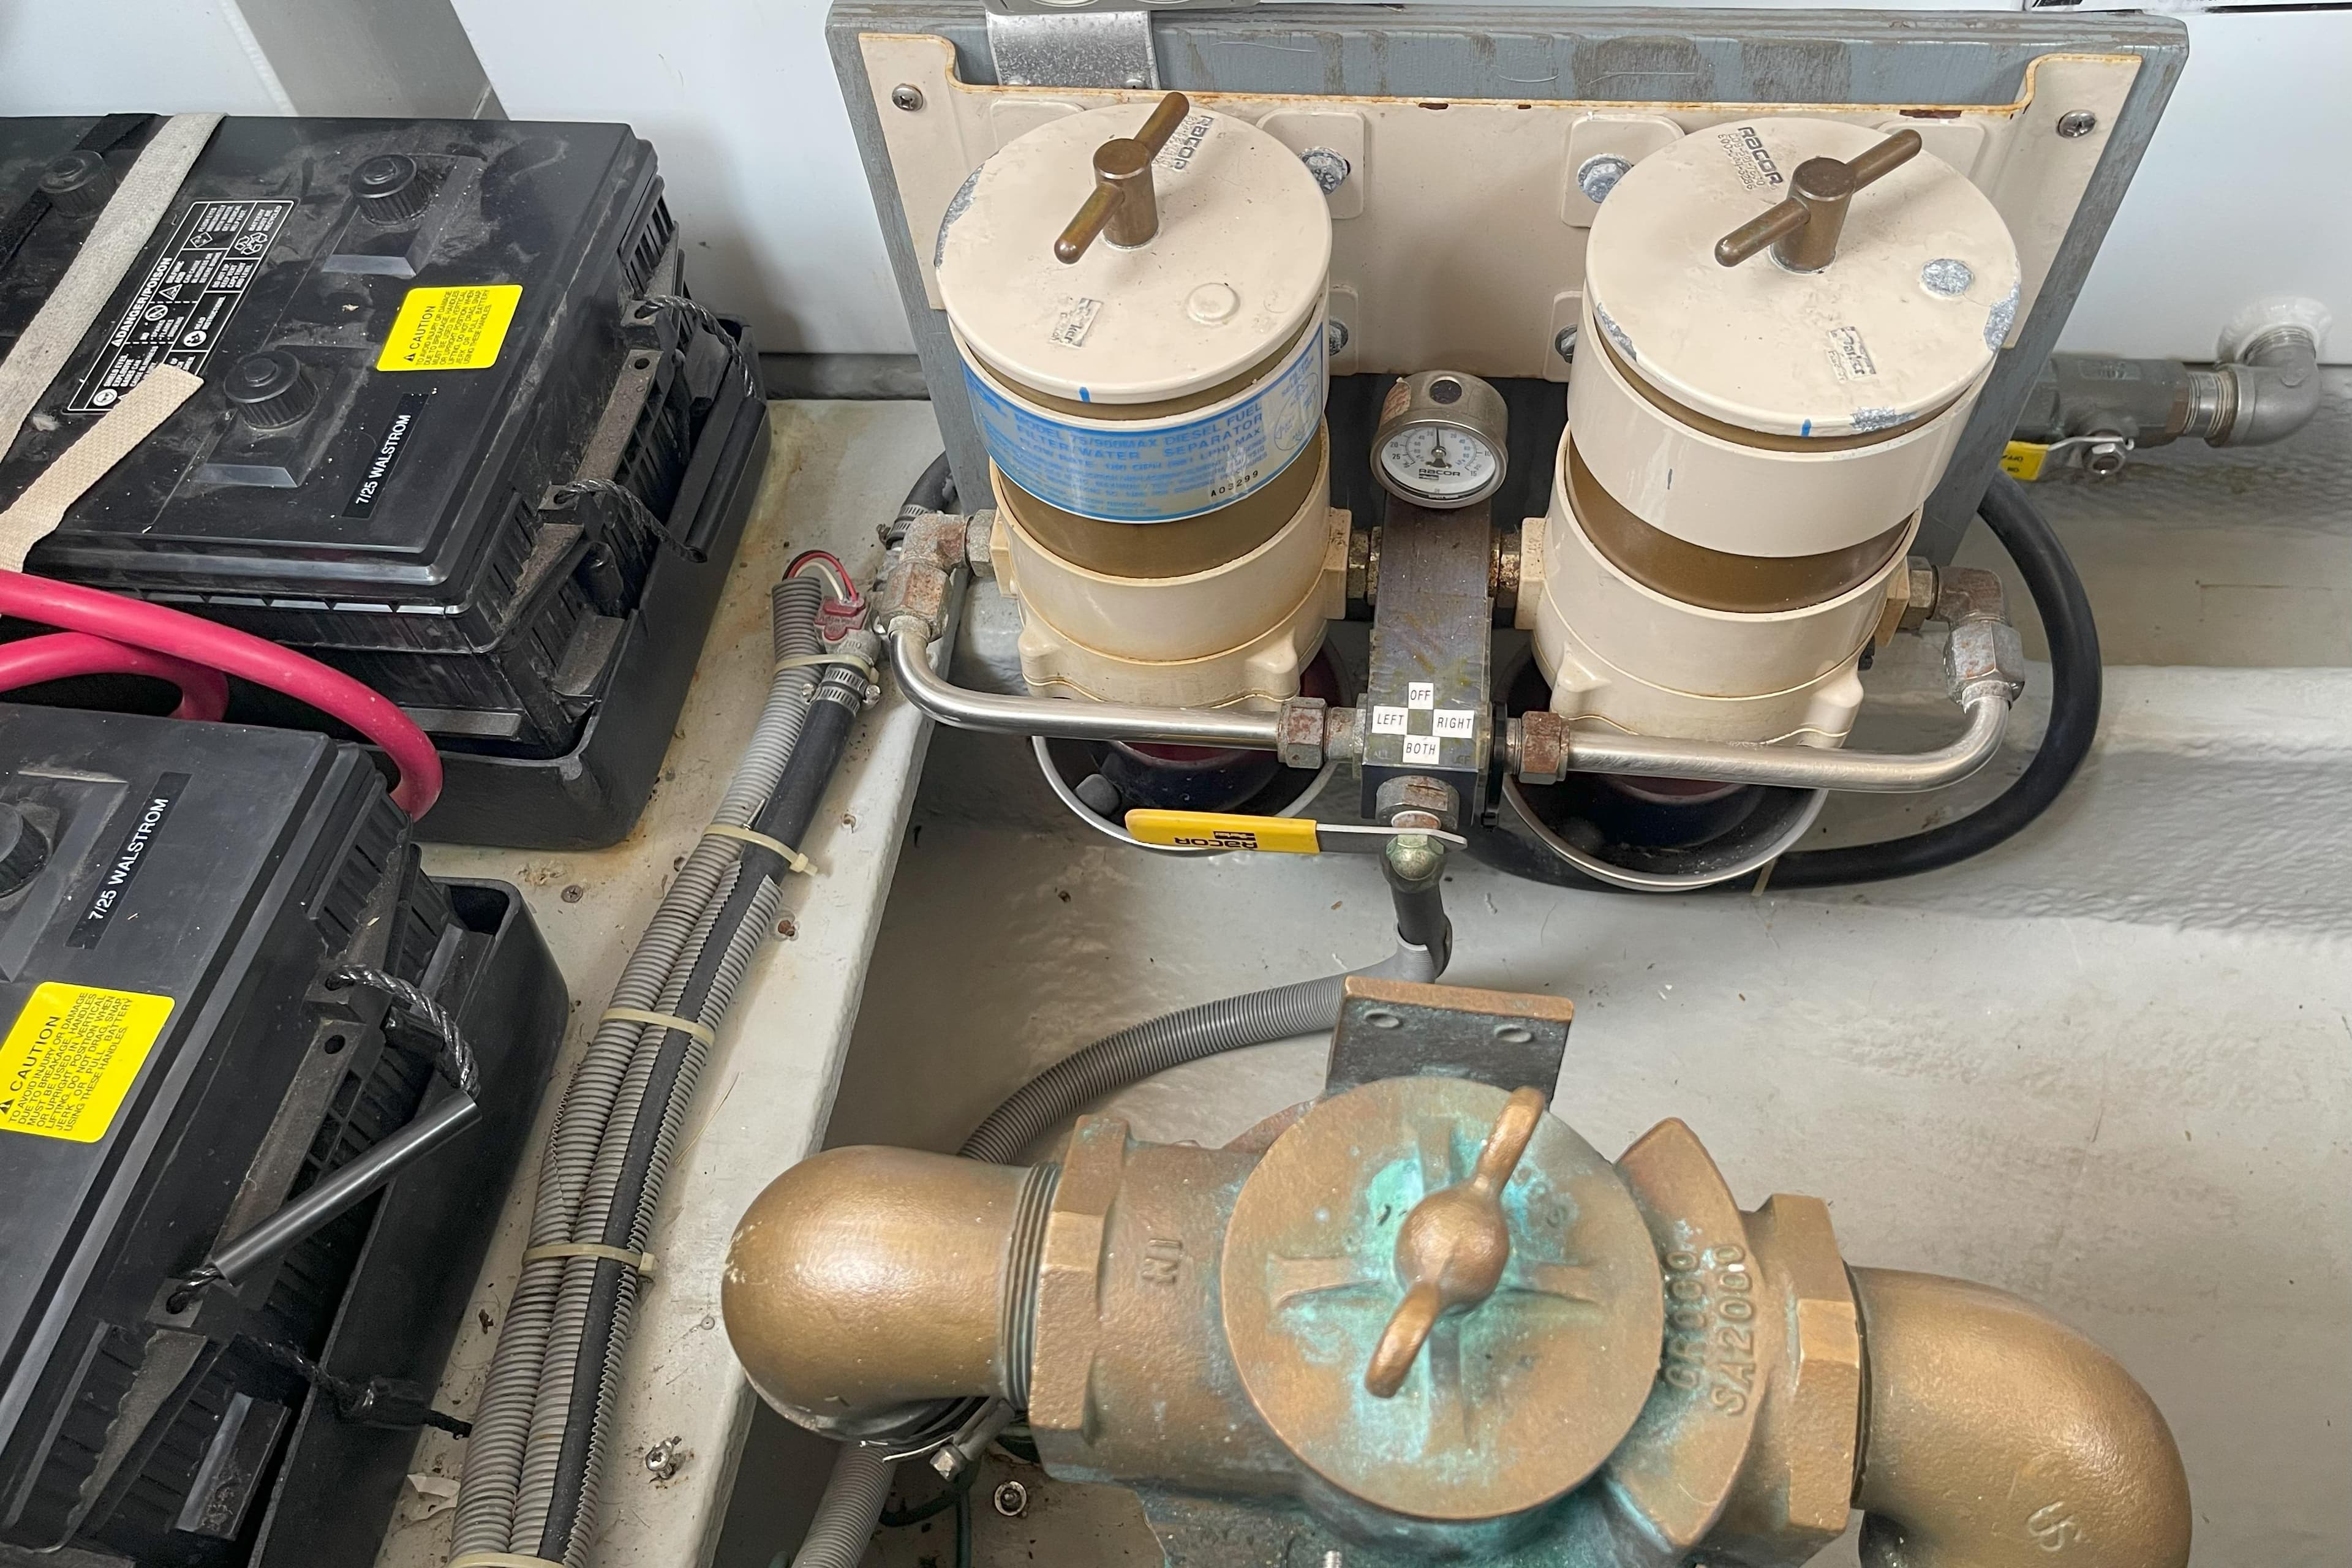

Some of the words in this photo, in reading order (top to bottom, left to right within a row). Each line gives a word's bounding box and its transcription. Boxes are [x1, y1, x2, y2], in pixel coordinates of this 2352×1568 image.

[248, 209, 266, 231] BATTERY
[263, 205, 282, 231] RECYCLED
[115, 258, 172, 338] DANGER/POISON
[174, 271, 186, 283] ACID
[409, 306, 435, 349] CAUTION
[424, 355, 434, 365] DUE
[445, 290, 459, 314] HANDLES
[426, 323, 438, 340] INJURY
[438, 291, 452, 312] DAMAGE
[443, 325, 453, 339] USED
[453, 291, 467, 315] VERTICAL
[456, 350, 466, 364] JERK
[462, 337, 470, 345] OR
[468, 318, 479, 333] PULL
[475, 290, 489, 314] BATTERY
[469, 331, 481, 346] THESE
[104, 369, 119, 386] SHIELD
[111, 359, 134, 386] EXPLOSIVE
[1014, 412, 1065, 440] MODEL
[1164, 421, 1220, 445] DIESEL
[1227, 399, 1261, 427] FUEL
[1016, 423, 1138, 459] FILTER/WATER
[1164, 412, 1262, 457] SEPARATOR
[355, 477, 380, 505] 7/25
[371, 414, 411, 478] WALSTROM
[1210, 469, 1258, 497] A03299
[1411, 690, 1431, 701] OFF
[1377, 714, 1404, 726] LEFT
[1437, 717, 1472, 730] RIGHT
[1406, 742, 1436, 755] BOTH
[88, 889, 117, 921] 7/25
[113, 797, 168, 885] WALSTROM
[9, 1110, 21, 1121] TO
[17, 1081, 37, 1109] AVOID
[32, 1047, 56, 1079] INJURY
[53, 1032, 65, 1045] OR
[61, 993, 88, 1030] DAMAGE
[10, 1016, 60, 1091] CAUTION
[18, 1106, 34, 1124] DUE
[29, 1090, 42, 1102] TO
[68, 993, 97, 1034] HANDLES
[27, 1100, 46, 1126] MUST
[43, 1084, 56, 1096] BE
[52, 1055, 72, 1080] USED
[68, 1042, 79, 1052] IN
[75, 995, 107, 1038] VERTICAL
[37, 1114, 50, 1127] OR
[45, 1071, 72, 1110] UPRIGHT
[69, 1025, 99, 1066] POSITION
[94, 996, 115, 1021] WHEN
[56, 1104, 75, 1130] JERK
[74, 1082, 87, 1096] OR
[85, 1050, 105, 1074] PULL
[104, 998, 132, 1041] BATTERY
[67, 1076, 80, 1089] DO
[76, 1055, 91, 1073] NOT
[64, 1103, 85, 1131] USING
[81, 1072, 103, 1099] THESE
[97, 1027, 127, 1069] HANDLES.
